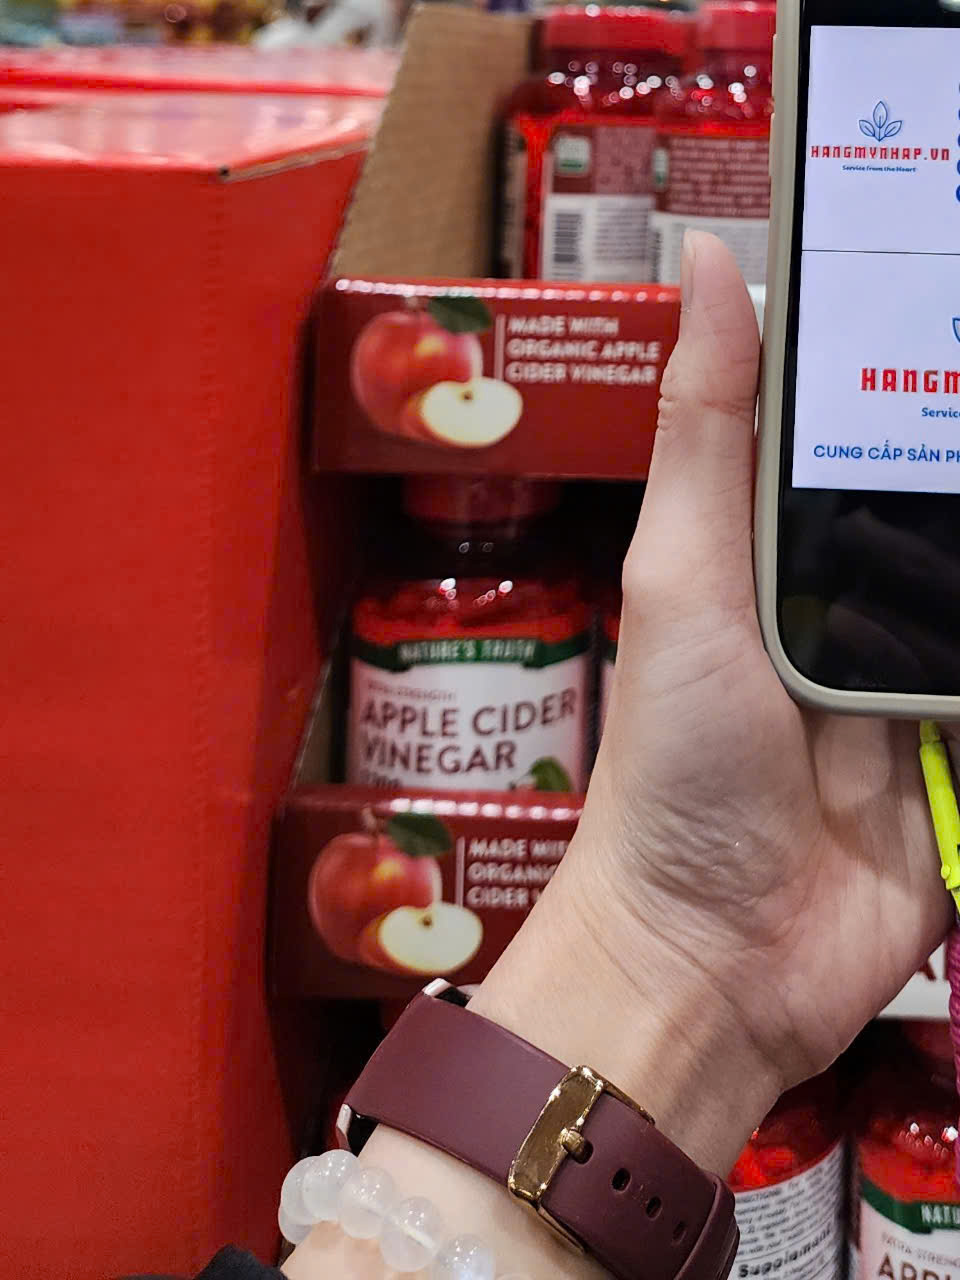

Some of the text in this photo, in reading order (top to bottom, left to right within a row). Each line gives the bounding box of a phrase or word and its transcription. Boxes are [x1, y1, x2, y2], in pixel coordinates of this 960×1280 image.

[506, 339, 661, 362] ORGANIC APPLE
[505, 362, 568, 383] CIDER
[813, 445, 863, 459] CUNG
[868, 439, 902, 461] CẤP
[908, 444, 940, 462] SẢN
[361, 686, 578, 738] APPLE CIDER
[363, 731, 517, 775] VINEGAR
[469, 839, 527, 858] MADE
[467, 887, 529, 907] CIDER
